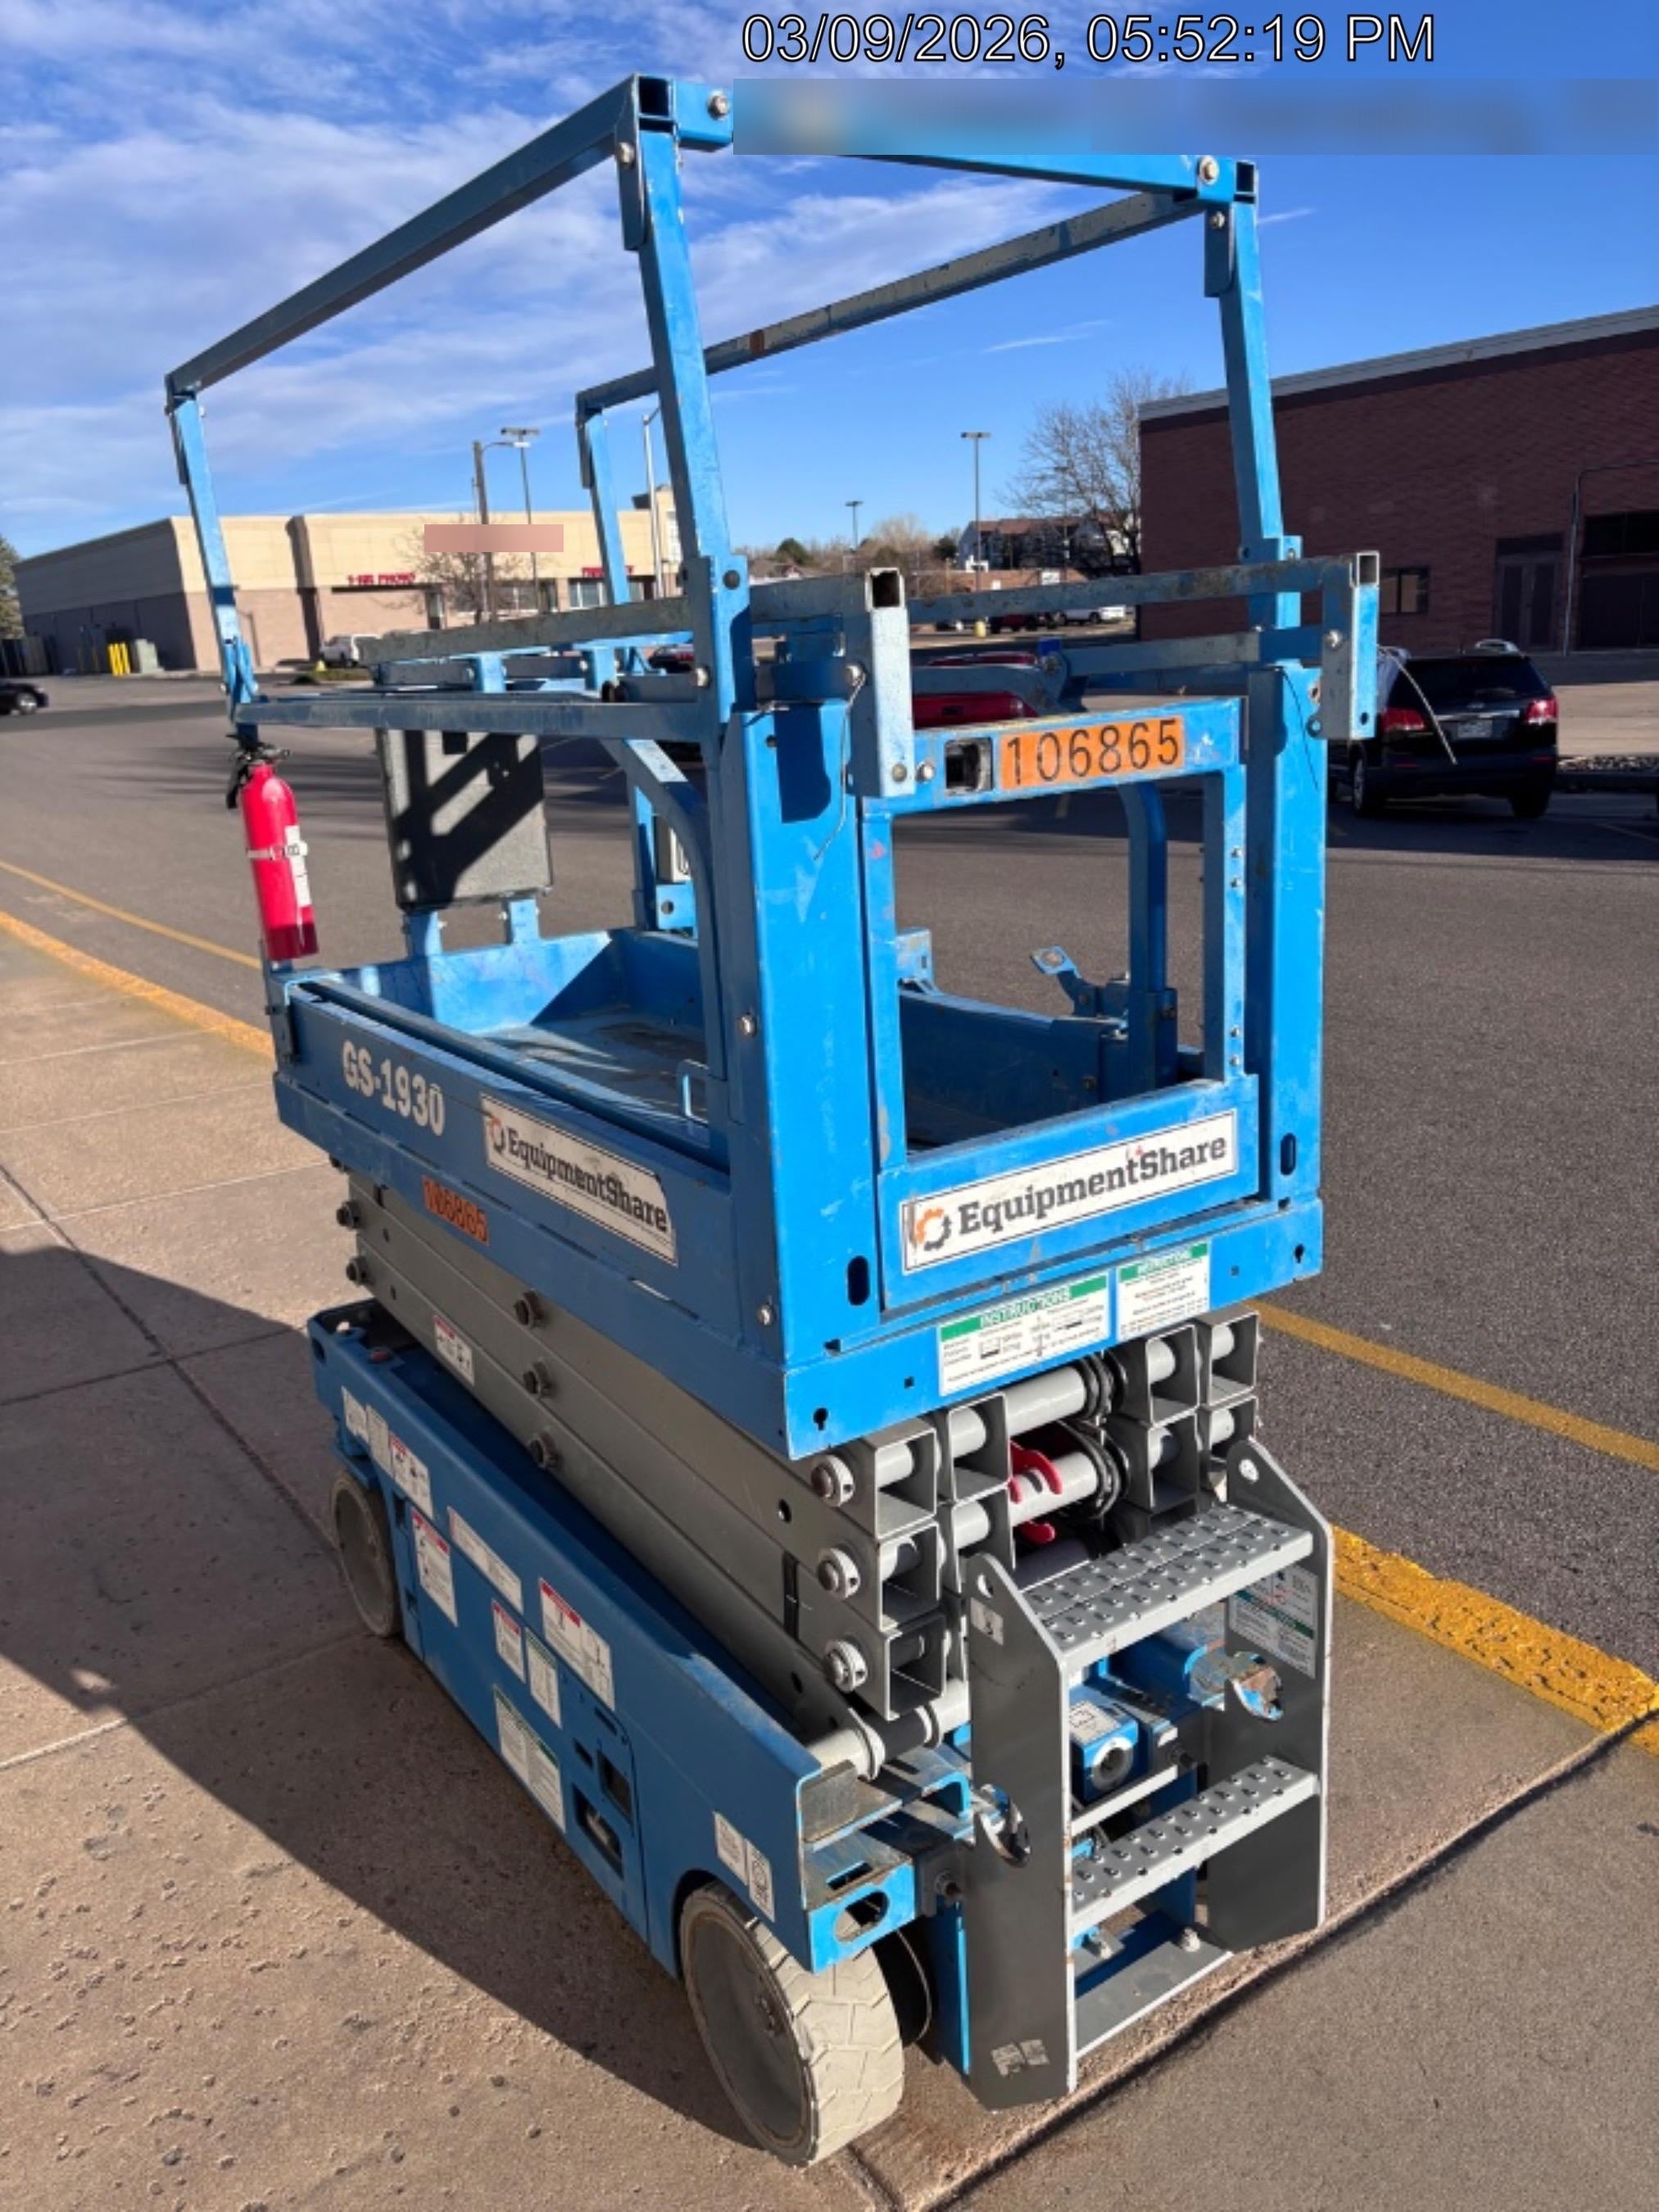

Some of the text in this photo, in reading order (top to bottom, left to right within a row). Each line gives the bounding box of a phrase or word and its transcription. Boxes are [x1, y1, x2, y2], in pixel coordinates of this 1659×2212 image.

[1007, 718, 1180, 786] 106865
[342, 1040, 445, 1135] GS-1930
[506, 1126, 668, 1231] EquipmentShare
[958, 1136, 1226, 1235] EquipmentShare
